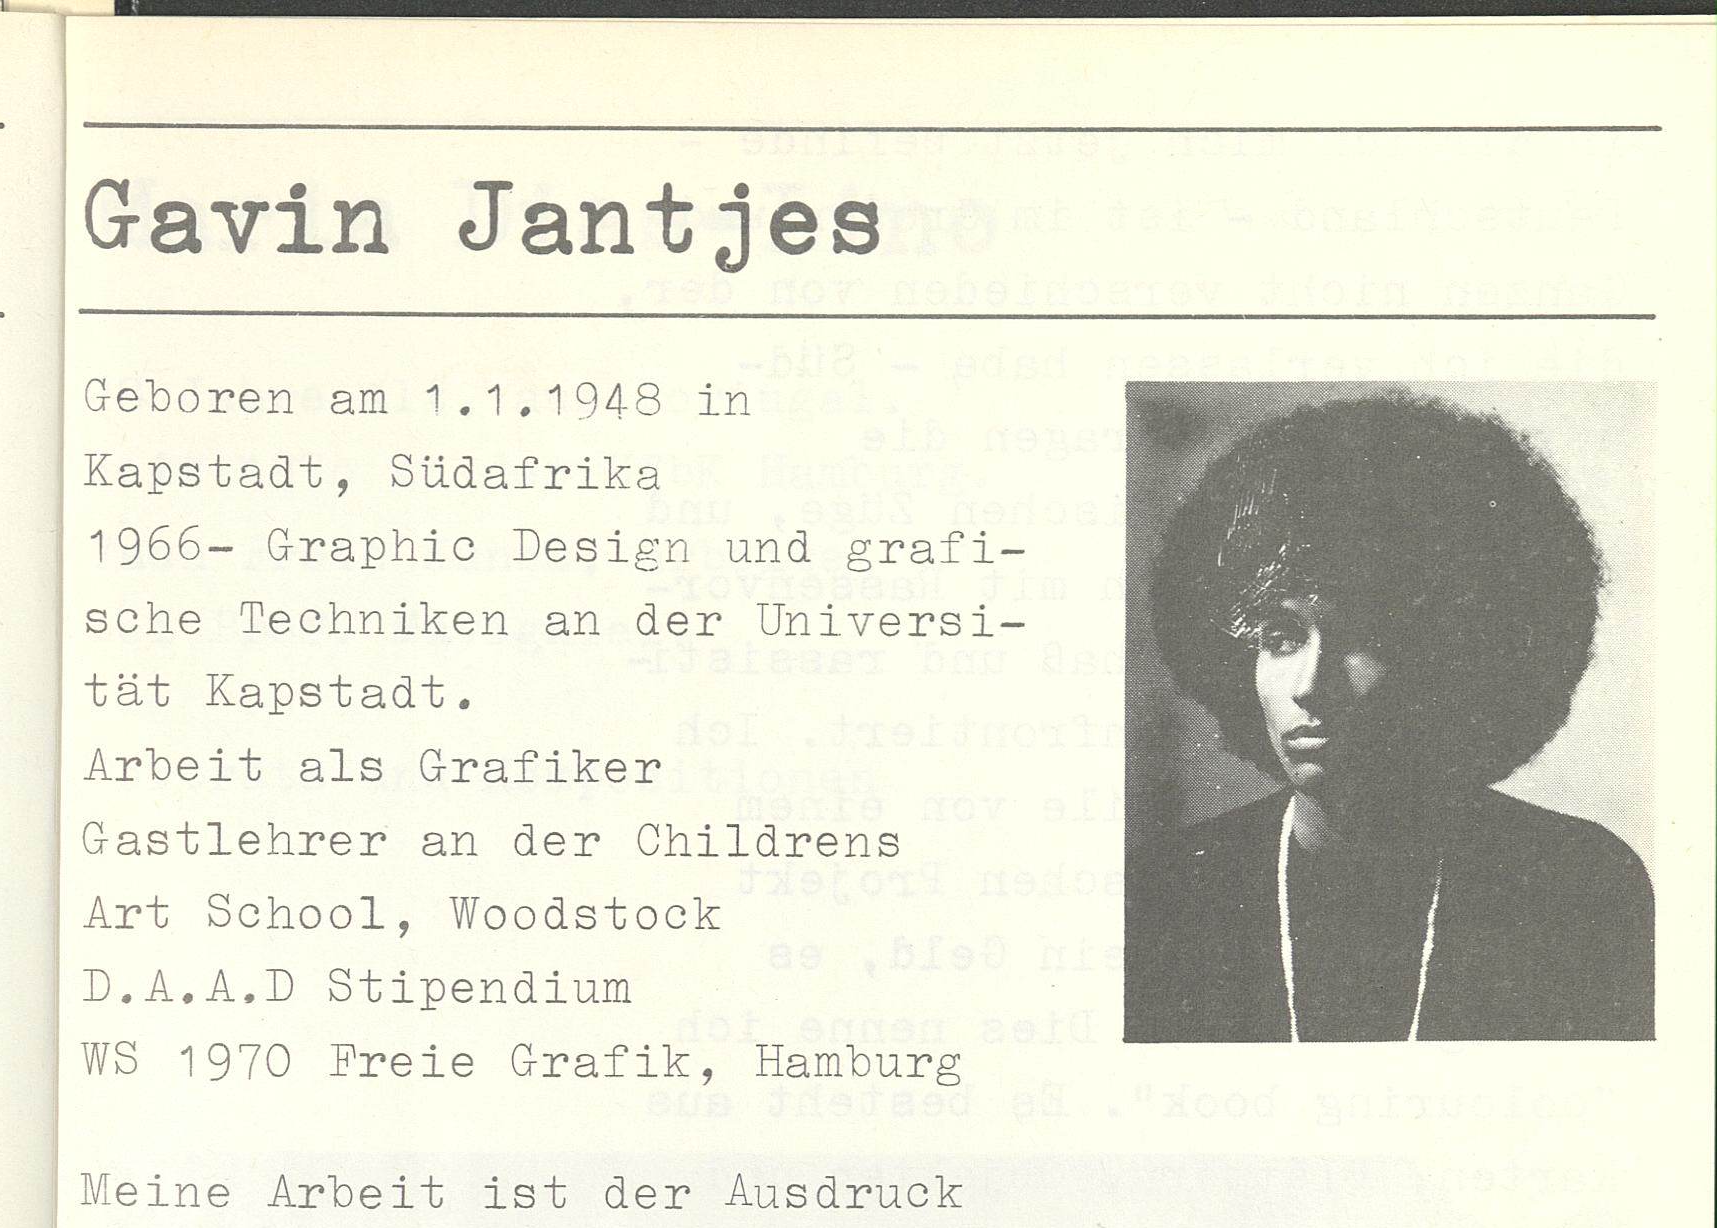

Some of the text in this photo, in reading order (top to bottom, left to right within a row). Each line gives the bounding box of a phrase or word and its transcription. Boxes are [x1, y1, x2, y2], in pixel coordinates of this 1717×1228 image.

[86, 179, 388, 254] Gavin
[459, 181, 879, 273] Jantjes
[85, 378, 293, 414] Geboren
[331, 389, 387, 415] am
[427, 382, 660, 417] 1.1.1948
[699, 382, 750, 416] in
[84, 454, 659, 497] Kapstadt, Südafrika
[91, 525, 1025, 572] 1966- Graphic Design und grafi-
[86, 601, 1025, 637] sche Techniken an der Universi-
[85, 673, 470, 715] tät Kapstadt.
[84, 748, 661, 783] Arbeit als Grafiker
[83, 821, 899, 857] Gastlehrer an der Childrens
[84, 893, 720, 938] Art School, Woodstock
[84, 968, 631, 1011] D.A.A.D Stipendium
[82, 1041, 960, 1086] WS 1970 Freie Grafik, Hamburg
[81, 1173, 229, 1207] Meine
[268, 1174, 443, 1209] Arbeit
[484, 1176, 566, 1209] ist
[605, 1176, 690, 1209] der
[725, 1173, 962, 1209] Ausdruck
